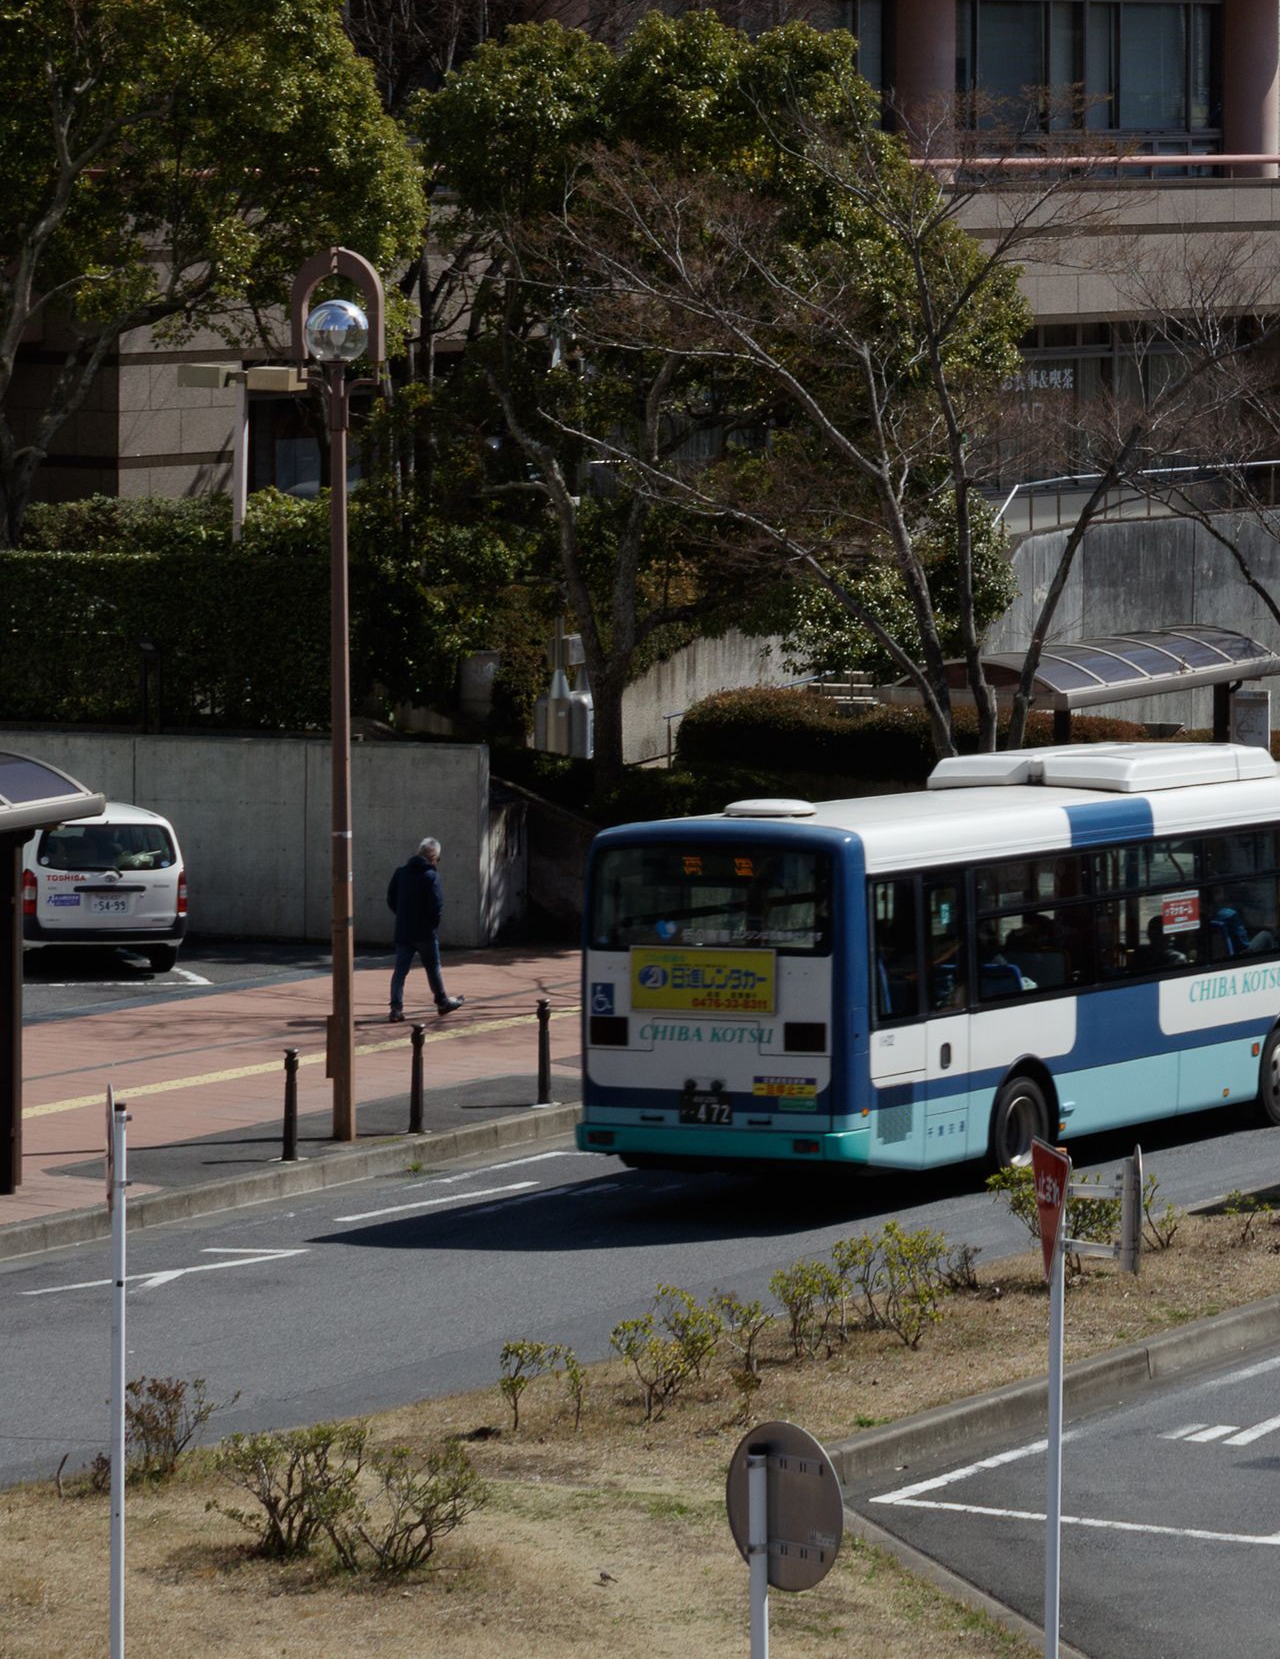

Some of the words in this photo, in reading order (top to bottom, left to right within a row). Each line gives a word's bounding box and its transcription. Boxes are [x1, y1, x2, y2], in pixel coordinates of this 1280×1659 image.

[46, 874, 86, 882] TOSHIBA
[671, 967, 768, 989] 日進レンタカー
[1188, 976, 1237, 1003] CHIBA
[639, 1023, 703, 1043] CHIBA
[710, 1027, 775, 1045] KOTSU
[1038, 1170, 1061, 1208] 止まれ
